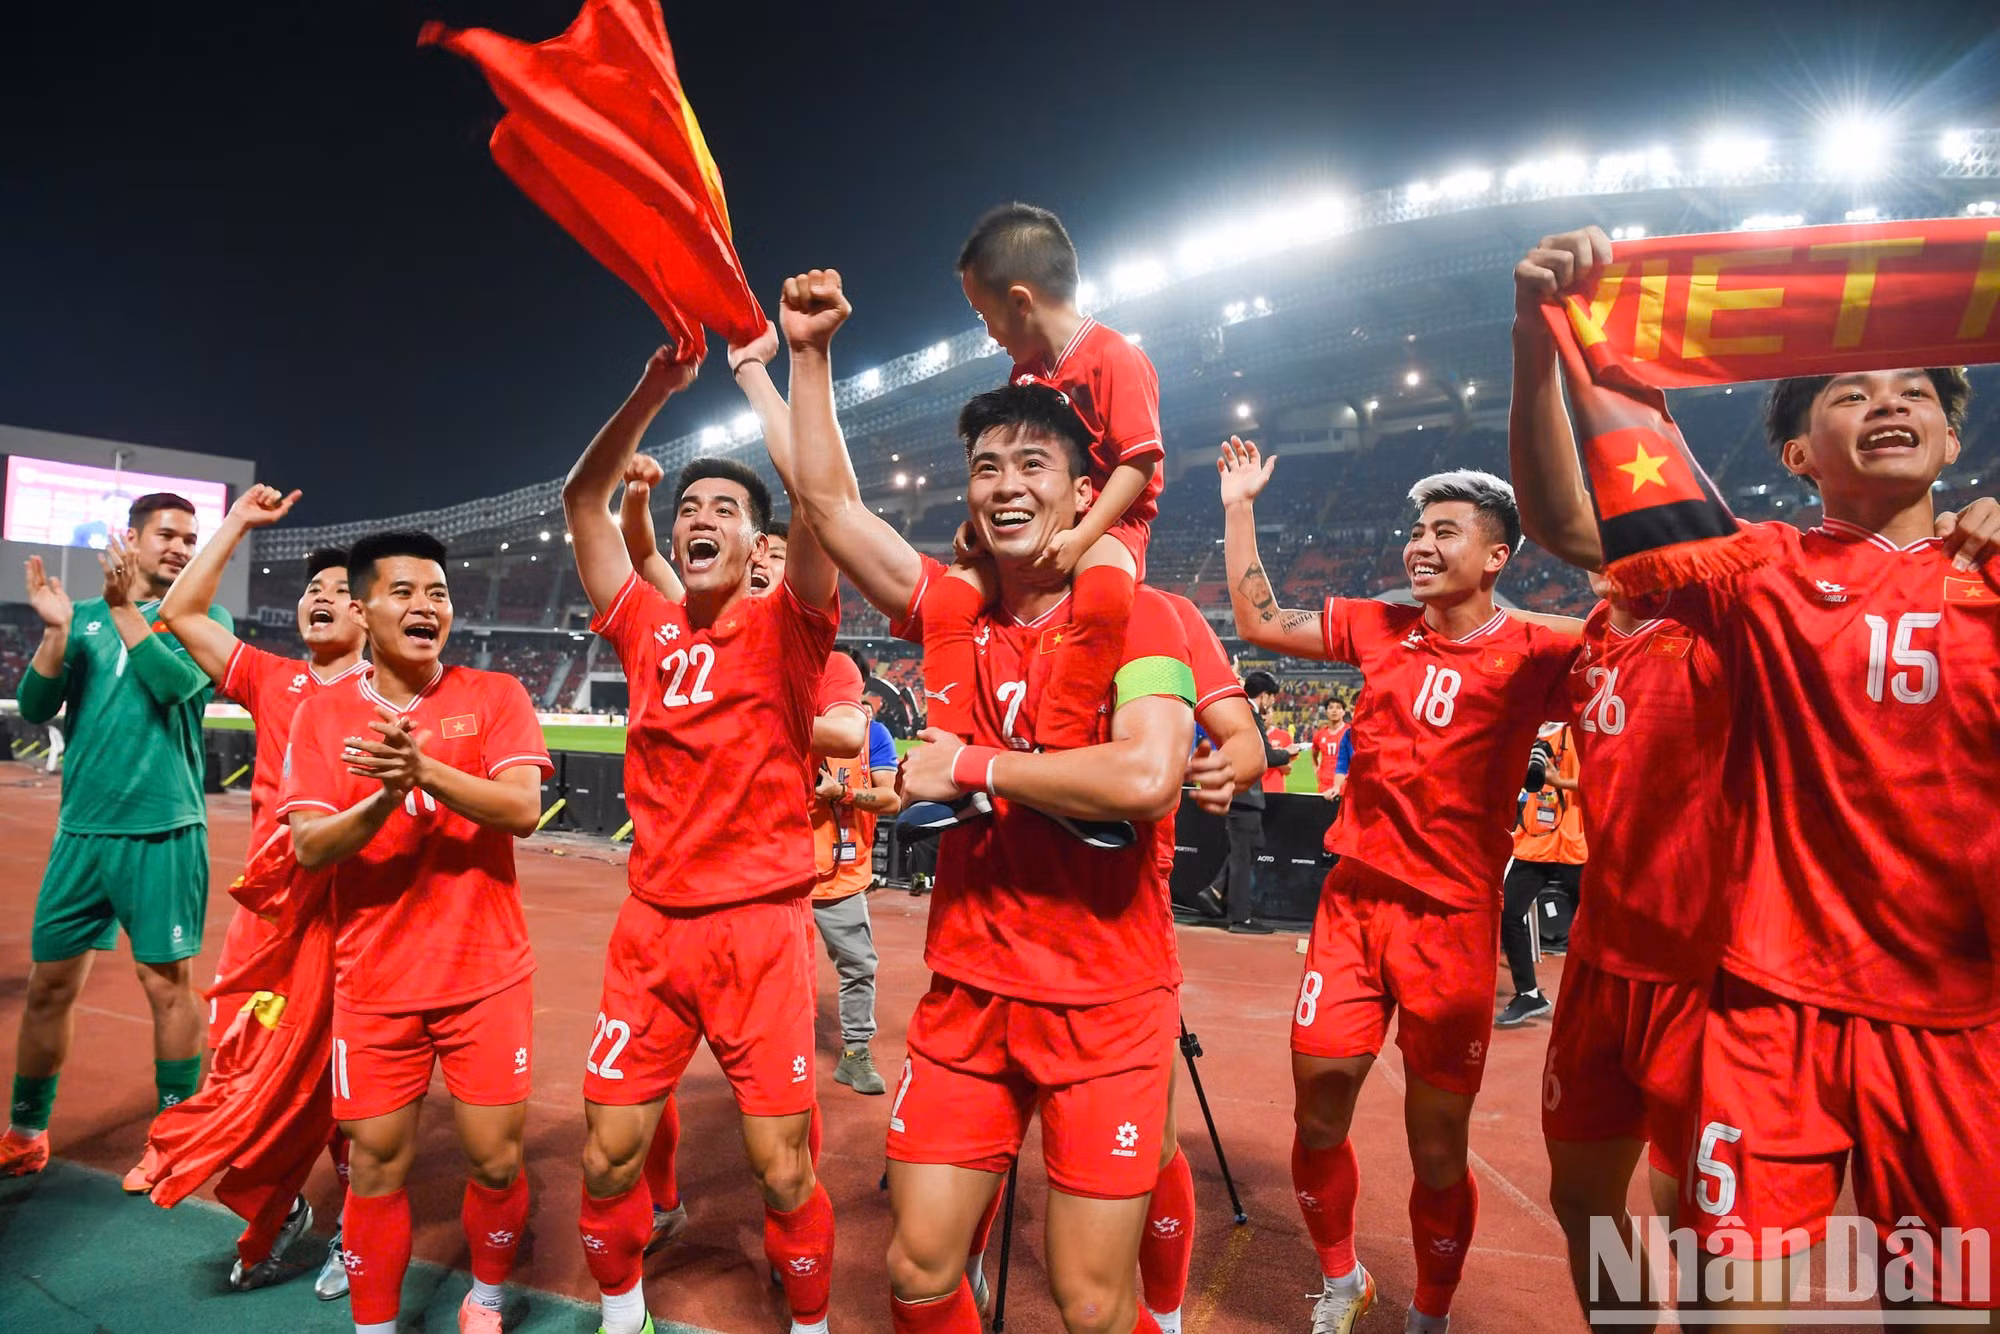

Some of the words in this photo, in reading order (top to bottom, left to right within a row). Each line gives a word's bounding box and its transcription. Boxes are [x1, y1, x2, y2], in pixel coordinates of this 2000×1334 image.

[661, 643, 715, 707] 22
[1864, 612, 1941, 704] 15
[1412, 664, 1462, 727] 18
[1579, 666, 1626, 735] 26
[586, 1011, 631, 1079] 22
